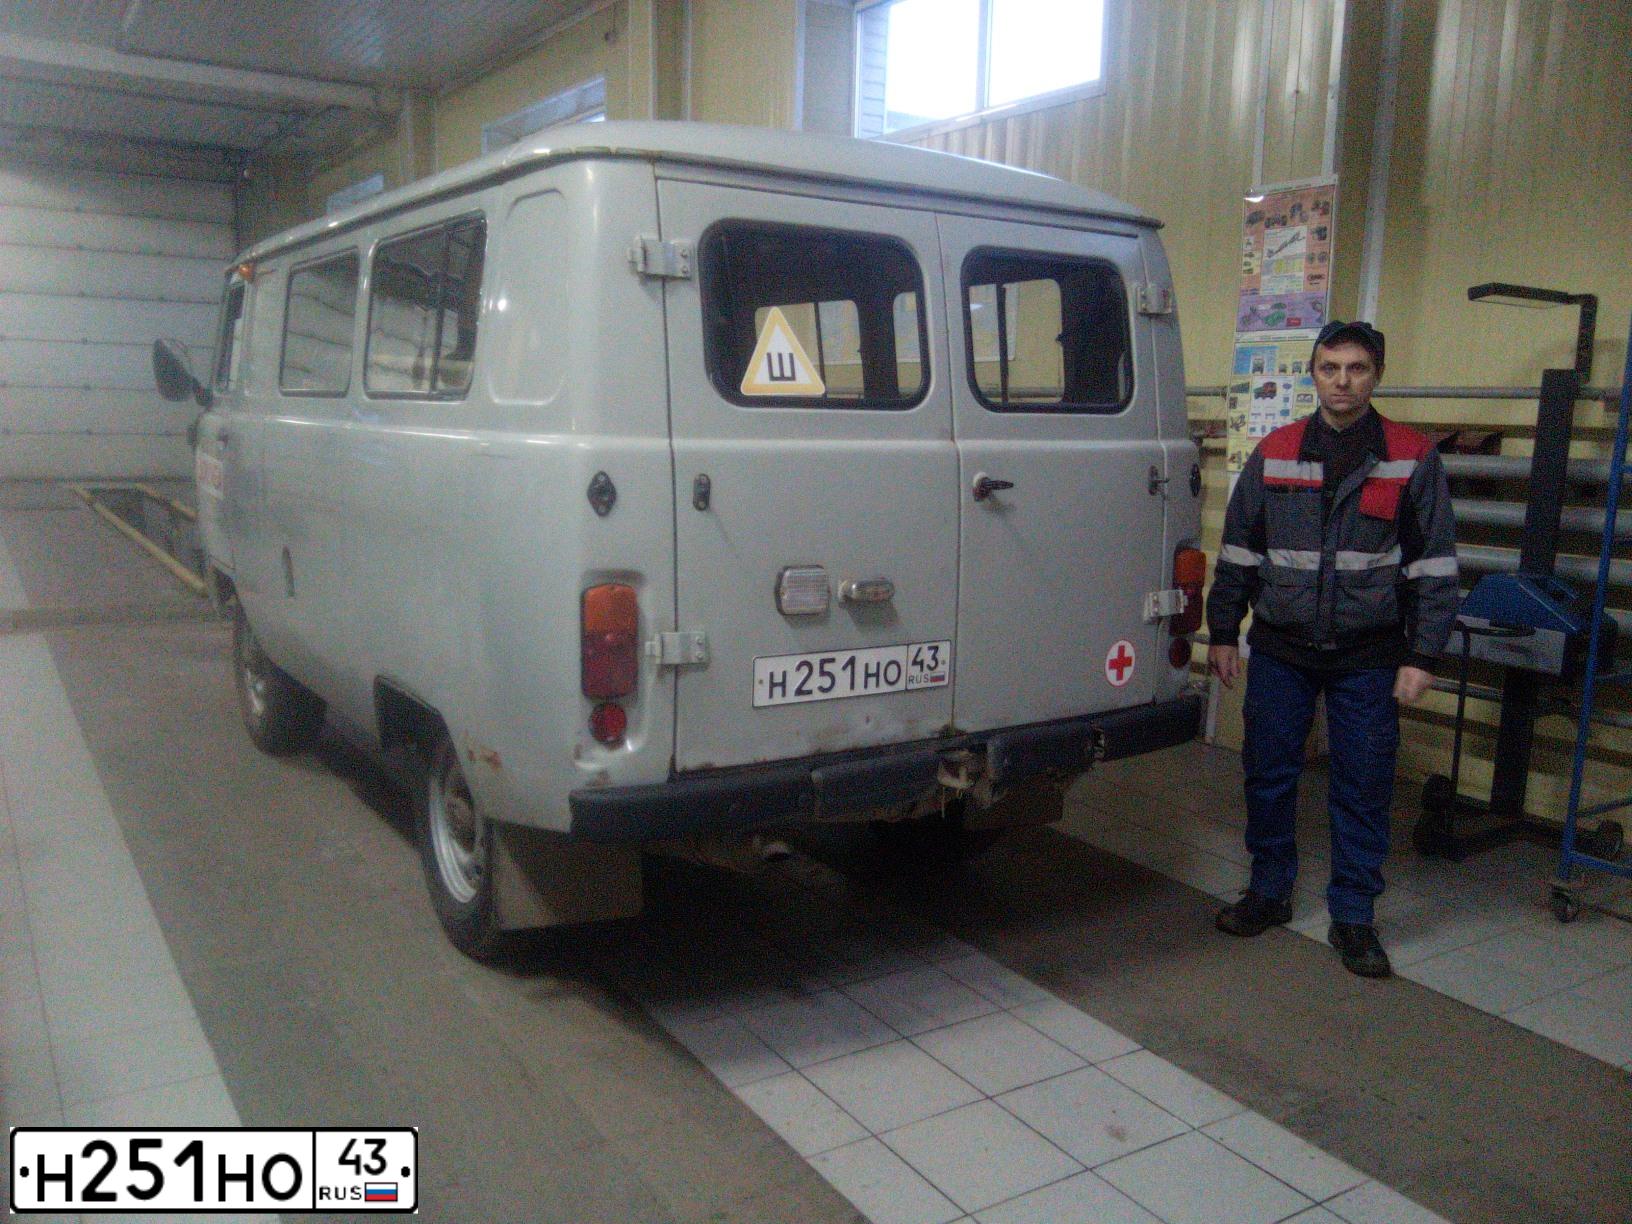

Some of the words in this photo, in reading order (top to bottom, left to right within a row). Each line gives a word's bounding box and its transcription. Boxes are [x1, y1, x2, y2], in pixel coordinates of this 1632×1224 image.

[766, 353, 796, 380] Ш
[911, 645, 939, 673] 43
[908, 673, 929, 685] RUS
